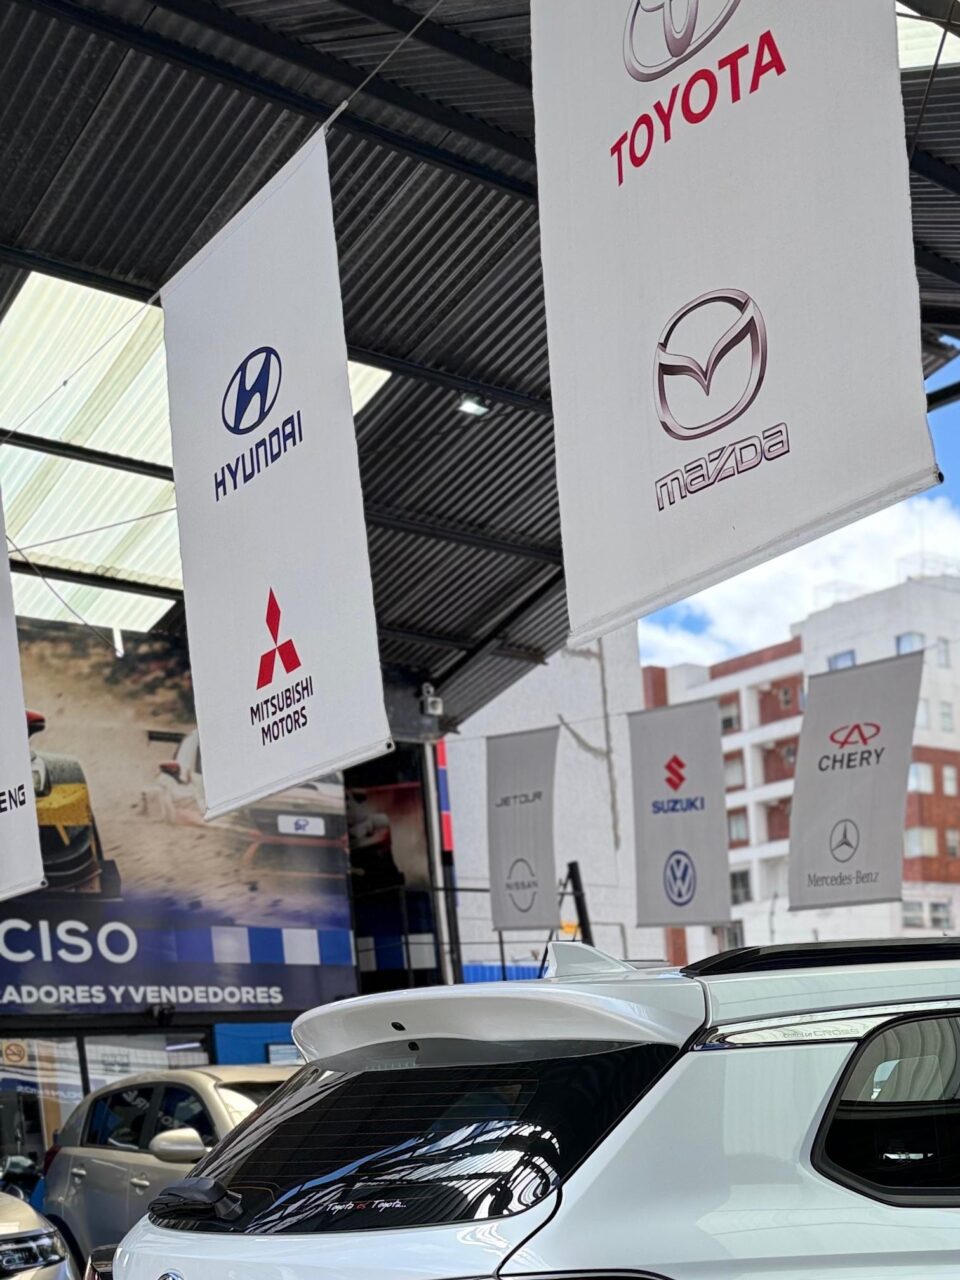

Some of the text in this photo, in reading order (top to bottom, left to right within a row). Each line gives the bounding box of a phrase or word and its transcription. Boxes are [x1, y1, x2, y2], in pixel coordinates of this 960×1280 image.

[610, 30, 786, 187] TOYOTA
[214, 410, 303, 502] HYUNDAI
[250, 676, 313, 725] MITSUBISHI
[262, 706, 308, 745] MOTORS
[818, 748, 885, 772] CHERY
[496, 791, 543, 807] JETOUR
[652, 797, 704, 814] SUZUKI
[505, 879, 538, 891] NISSAN
[807, 871, 879, 887] Mercedes-Benz
[0, 919, 138, 964] CISO
[0, 985, 283, 1004] ADORES Y VENDEDORES
